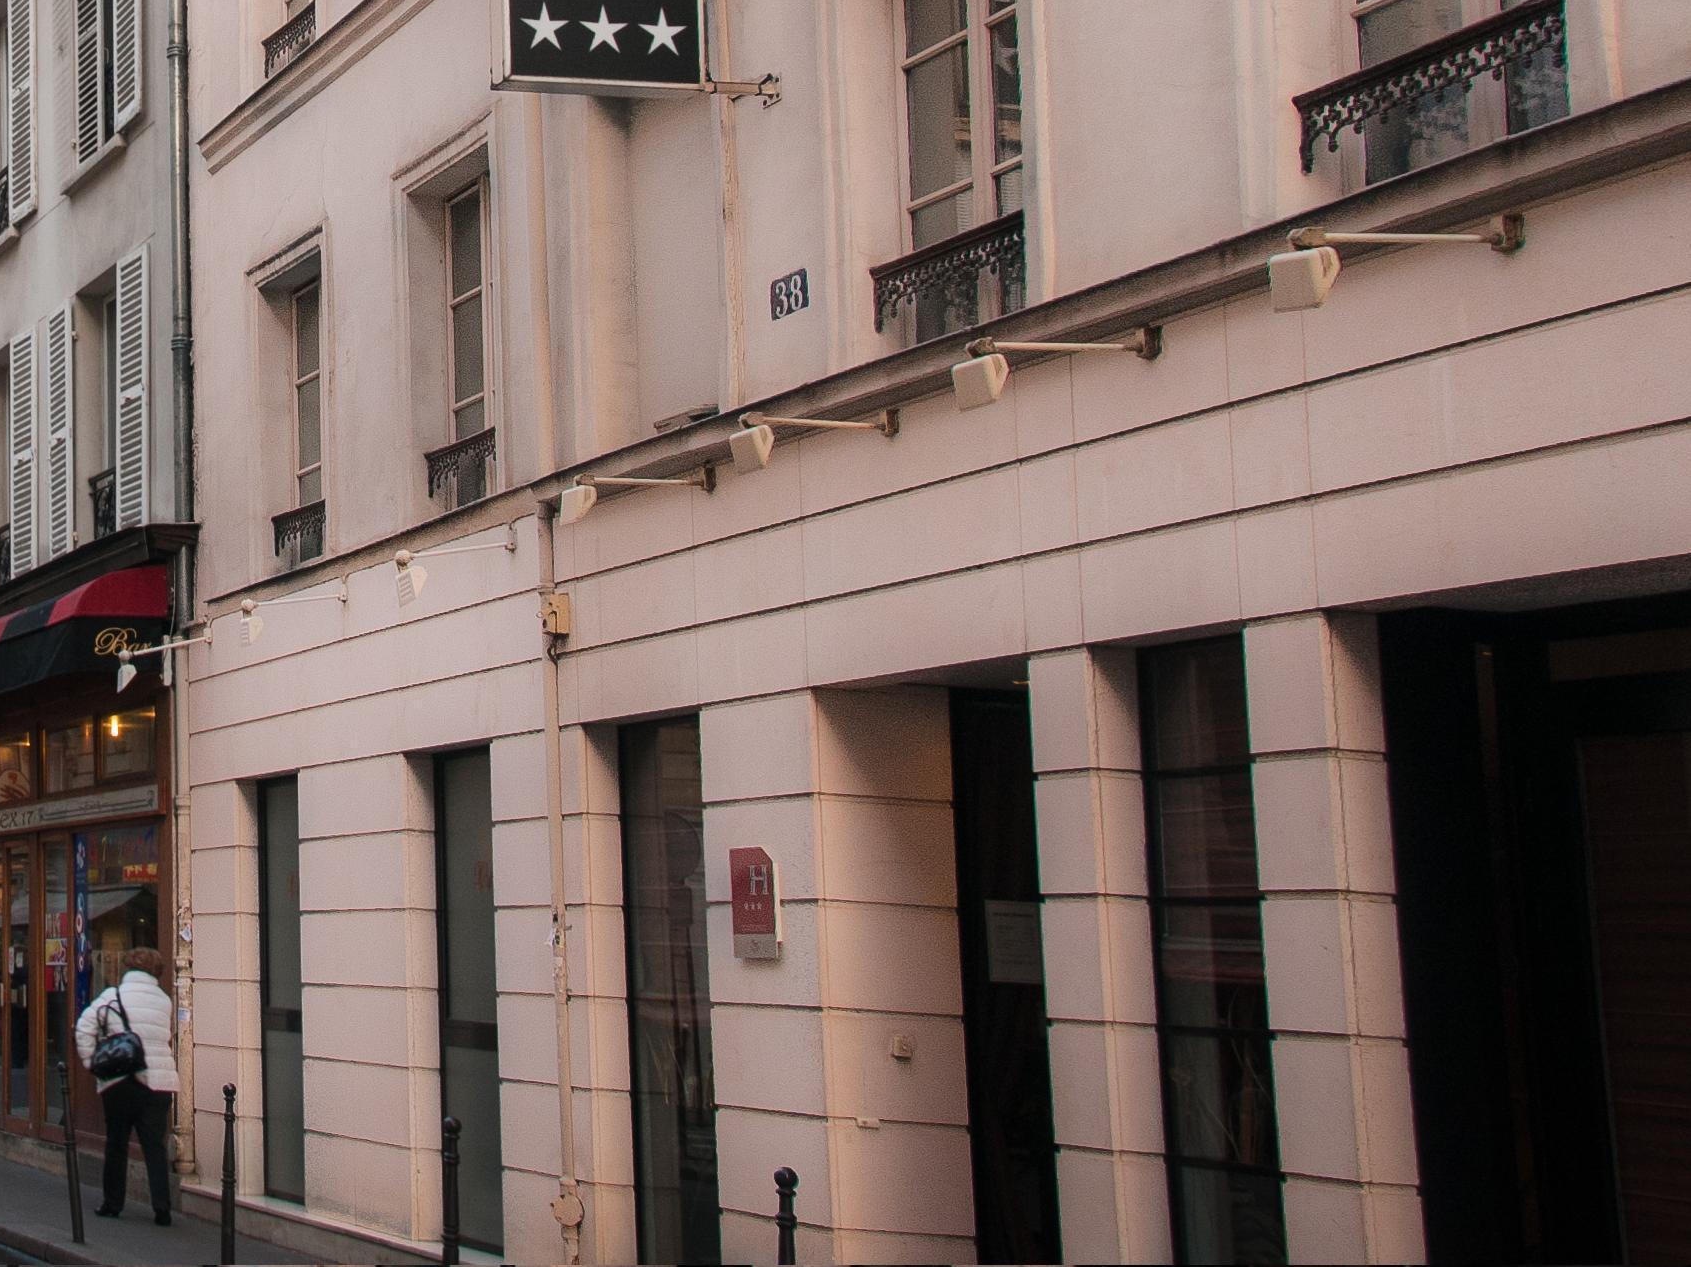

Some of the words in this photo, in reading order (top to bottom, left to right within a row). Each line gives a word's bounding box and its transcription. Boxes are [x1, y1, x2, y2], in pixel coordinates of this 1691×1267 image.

[775, 274, 803, 318] 38
[95, 627, 152, 655] Bar
[21, 811, 35, 827] 17
[748, 864, 769, 896] H
